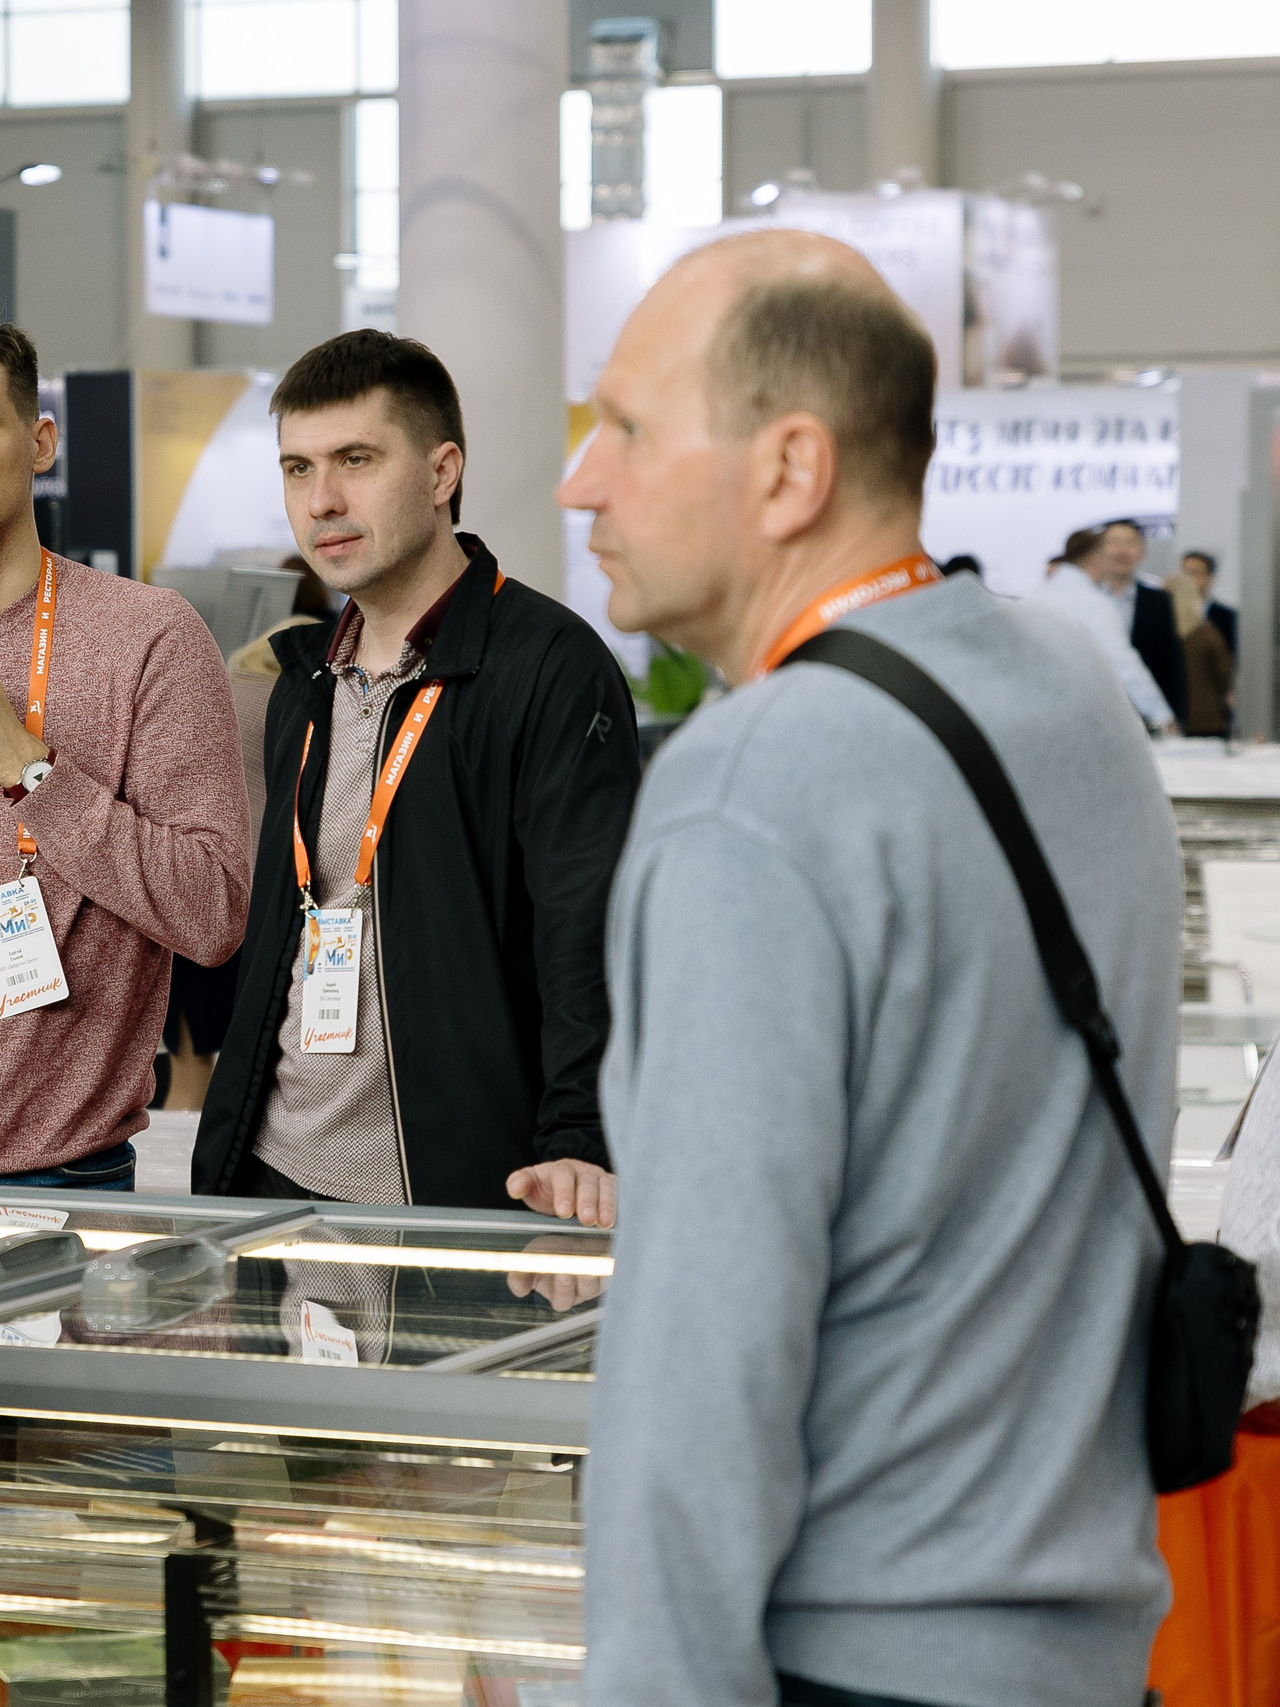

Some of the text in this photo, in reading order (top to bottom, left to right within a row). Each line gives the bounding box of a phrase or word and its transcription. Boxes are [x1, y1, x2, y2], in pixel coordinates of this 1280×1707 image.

[36, 556, 53, 675] МАГАЗИН И РЕСТОРАН
[385, 731, 415, 785] МАГАЗИН
[413, 712, 424, 723] И
[317, 917, 351, 925] ВЫСТАВКА
[303, 1026, 353, 1051] Участник
